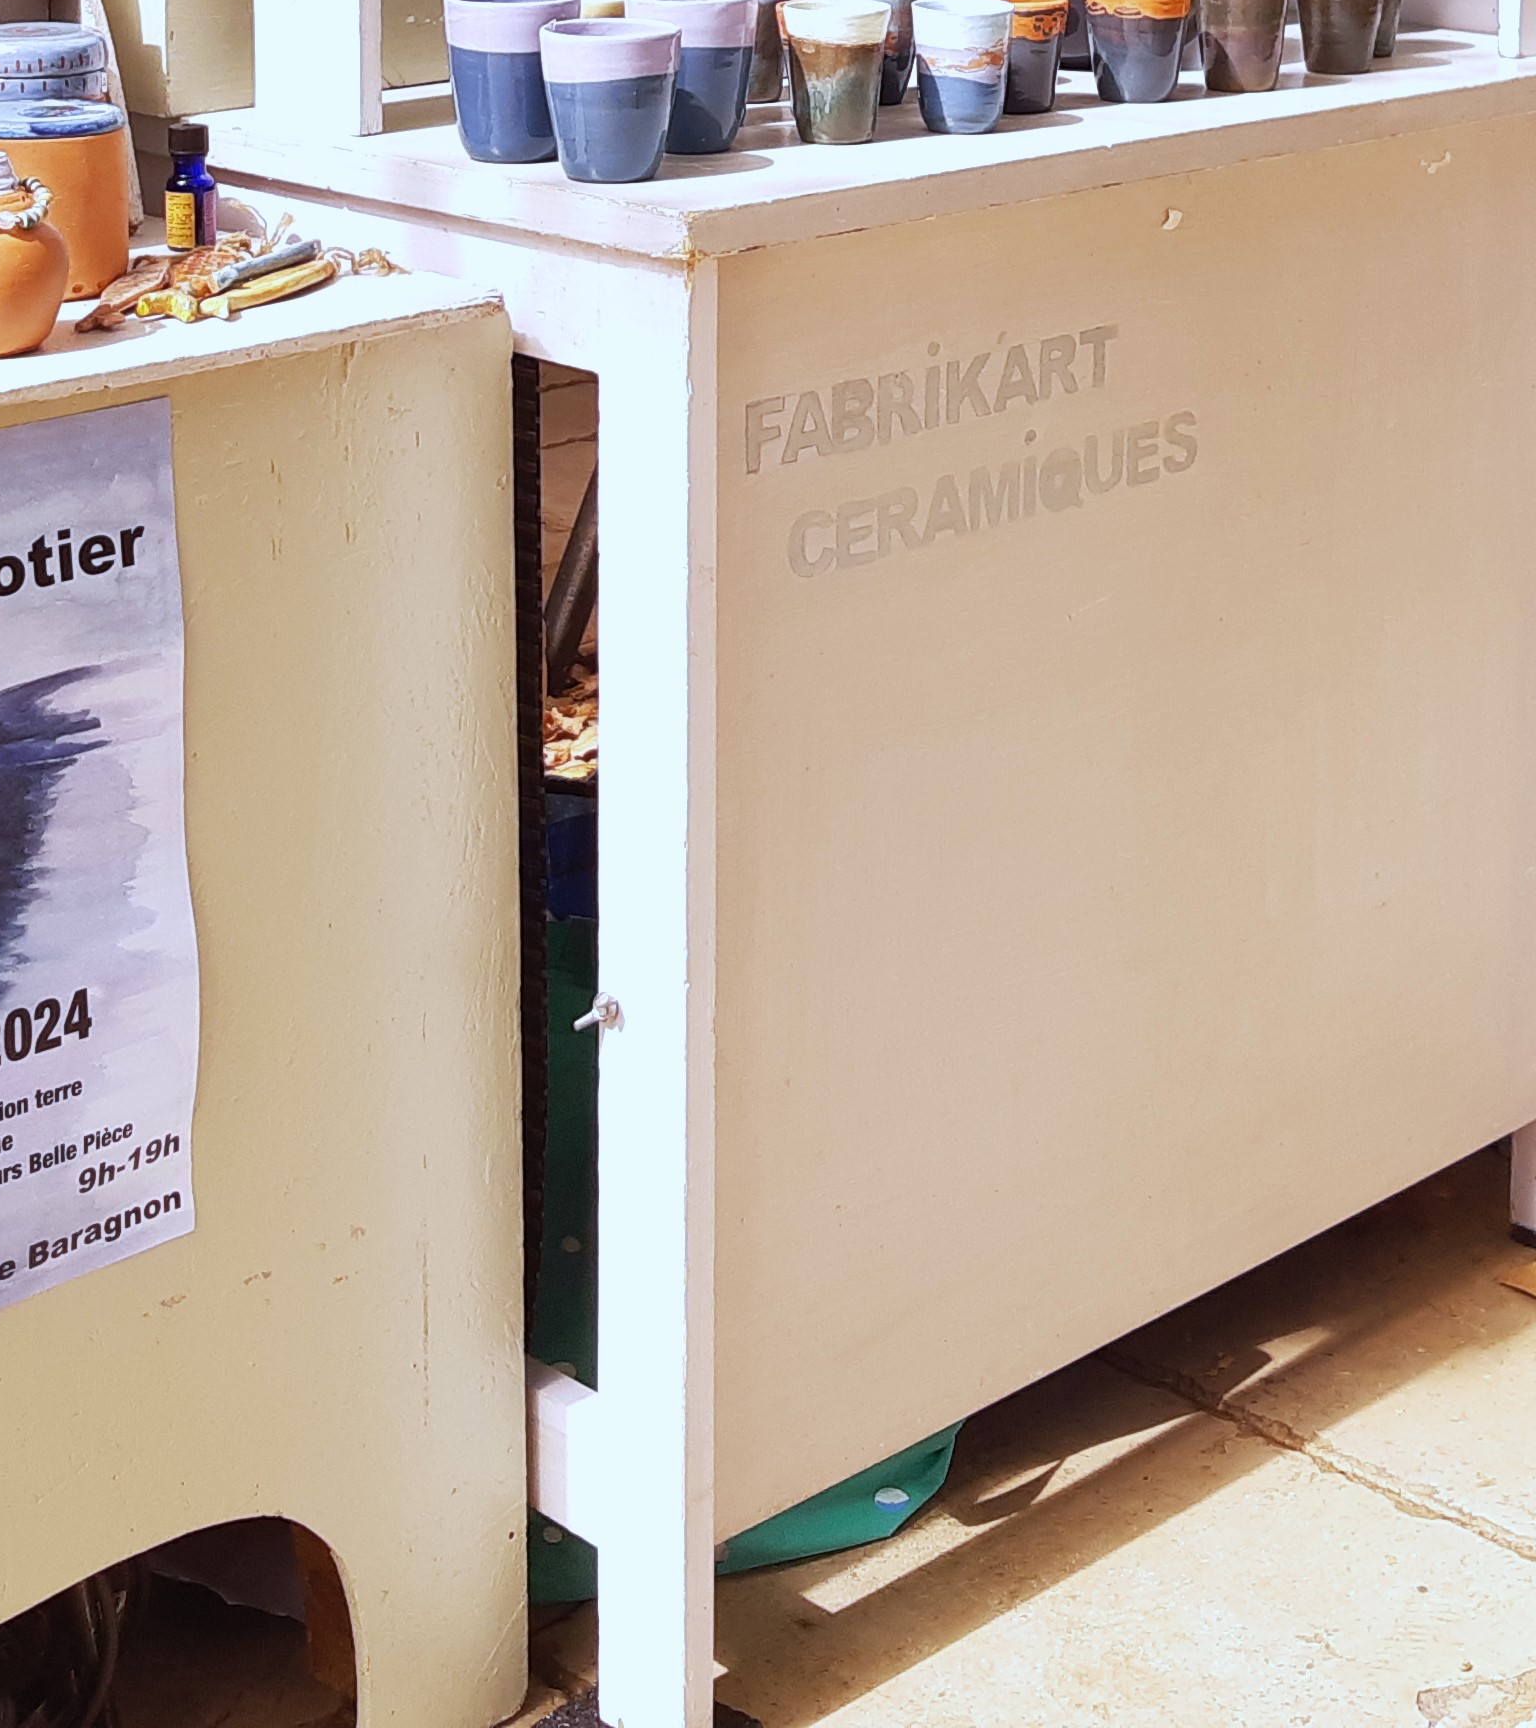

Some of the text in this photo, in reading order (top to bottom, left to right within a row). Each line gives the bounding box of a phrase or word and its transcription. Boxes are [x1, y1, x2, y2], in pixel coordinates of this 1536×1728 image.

[35, 1080, 83, 1109] terre
[29, 1143, 78, 1174] Belle
[83, 1123, 134, 1154] Pièce
[78, 1133, 180, 1193] 9h-19h
[28, 1191, 182, 1270] Baragnon
